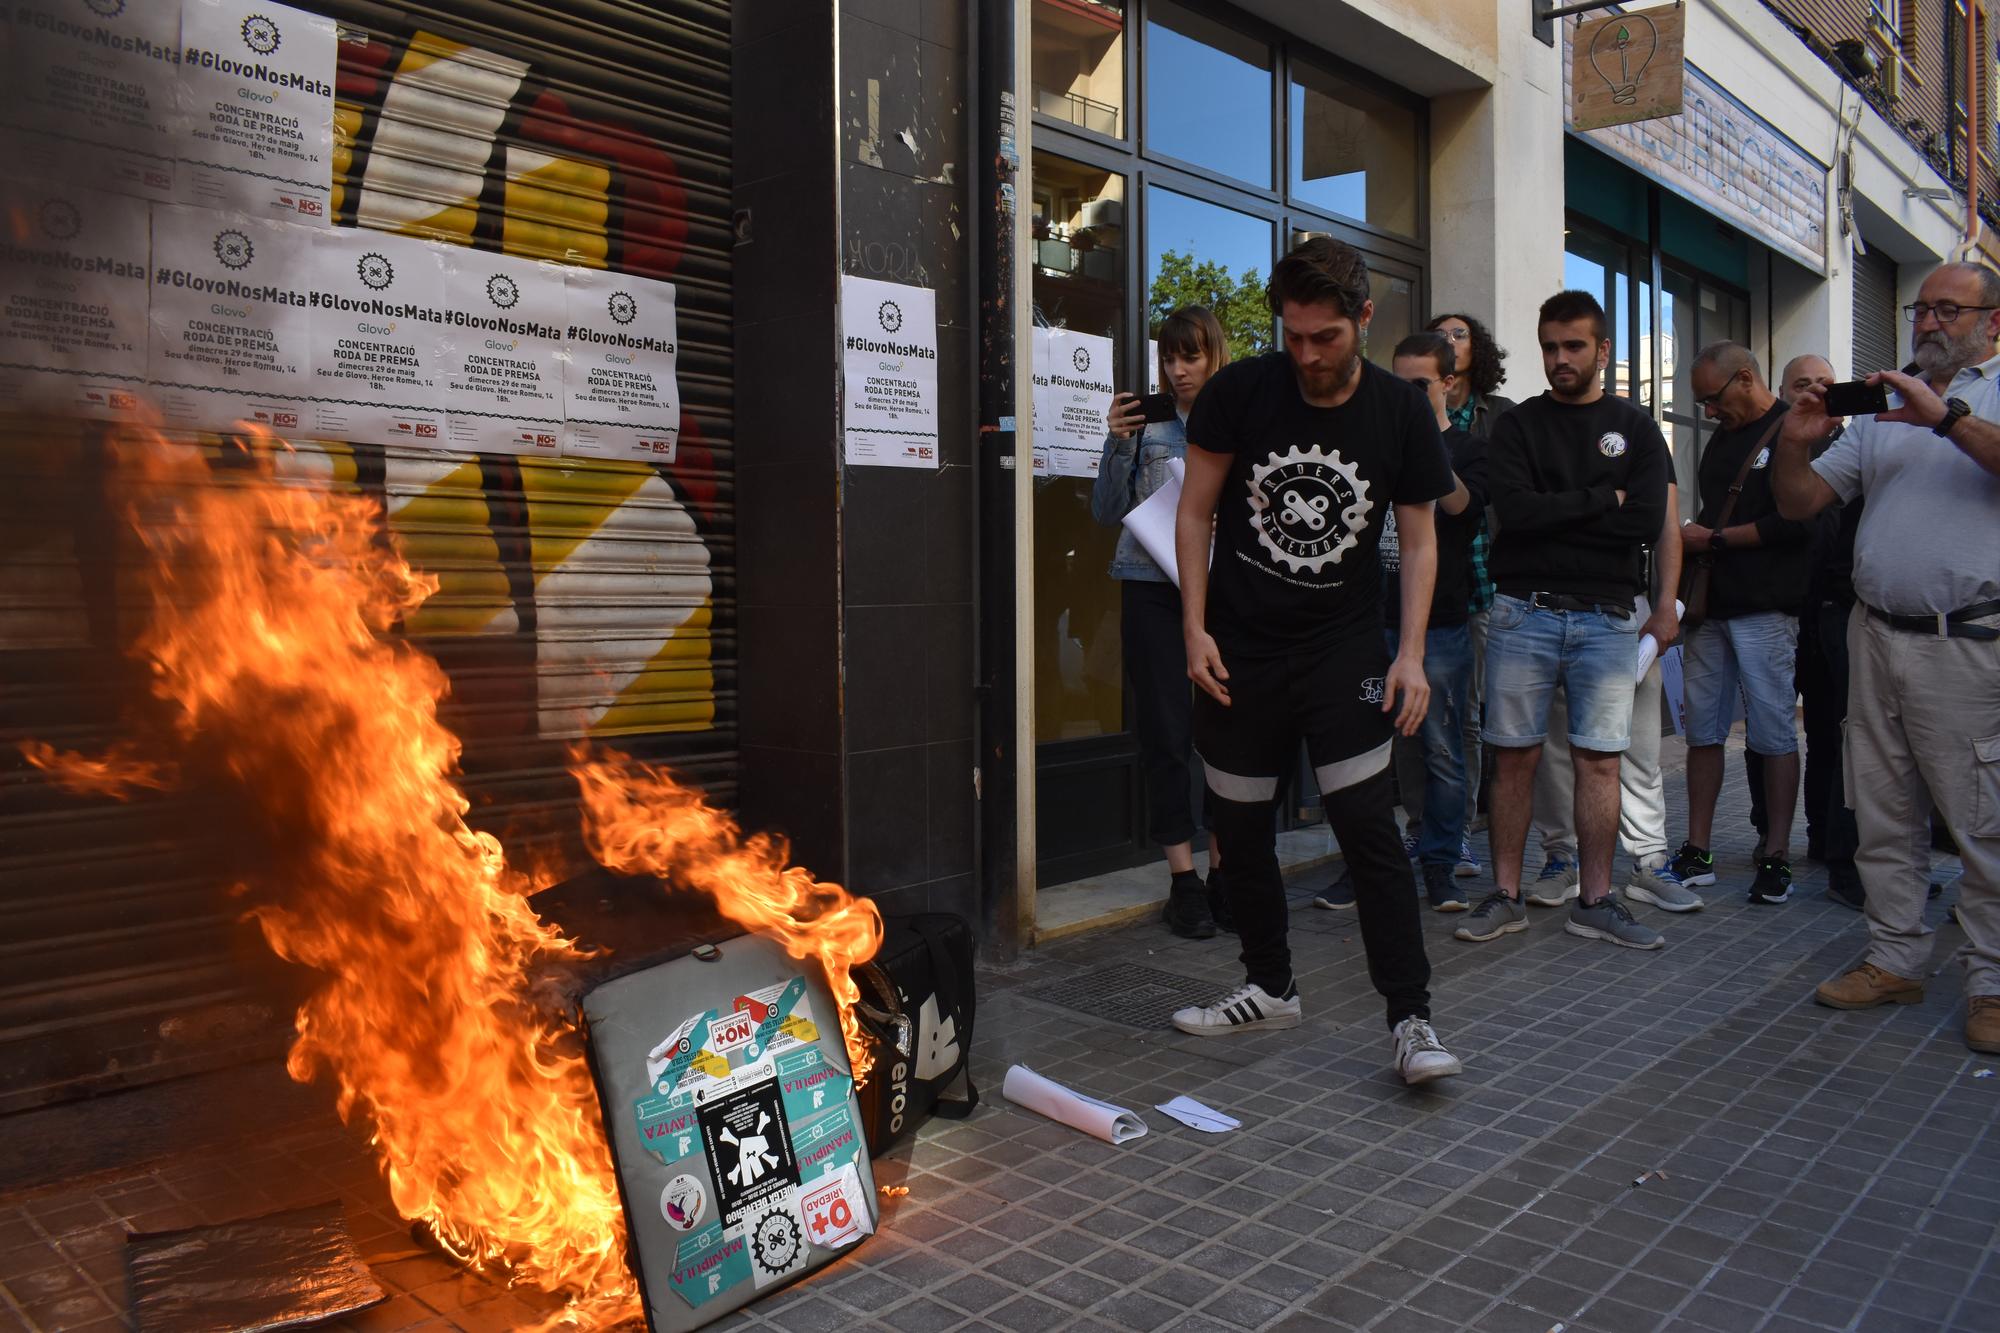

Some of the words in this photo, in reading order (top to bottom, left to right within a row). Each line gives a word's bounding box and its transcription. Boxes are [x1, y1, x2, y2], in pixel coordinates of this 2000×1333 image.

[186, 48, 332, 97] #GlovoNosMata
[237, 87, 273, 104] Glovo
[216, 102, 299, 128] CONCENTRACIÓ
[210, 112, 240, 126] RODA
[244, 119, 257, 130] DE
[261, 123, 303, 141] PREMSA
[256, 134, 266, 142] 29
[280, 140, 299, 151] maig
[249, 150, 266, 160] 18h.
[299, 199, 322, 212] NO+
[0, 240, 145, 279] GlovoNosMata
[157, 268, 306, 307] #GlovoNosMata
[12, 295, 109, 316] CONCENTRACIÓ
[211, 304, 247, 318] Glovo
[309, 291, 442, 324] #GlovoNosMata
[6, 307, 40, 319] RODA
[44, 311, 60, 322] DE
[64, 314, 114, 329] PREMSA
[445, 310, 560, 340] #GlovoNosMata
[189, 320, 274, 340] CONCENTRACIÓ
[358, 322, 390, 335] Glovo
[184, 331, 214, 343] RODA
[218, 336, 232, 346] DE
[235, 338, 279, 352] PREMSA
[339, 339, 415, 356] CONCENTRACIÓ
[485, 340, 513, 351] Glovo
[568, 327, 674, 354] #GlovoNosMata
[847, 336, 935, 360] #GlovoNosMata
[231, 349, 241, 357] 29
[255, 353, 275, 363] maig
[334, 350, 361, 360] RODA
[365, 353, 377, 362] DE
[380, 354, 419, 367] PREMSA
[468, 355, 535, 370] CONCENTRACIÓ
[605, 353, 631, 364] Glovo
[338, 362, 374, 372] dimecres
[398, 369, 415, 377] maig
[464, 365, 489, 374] RODA
[491, 368, 502, 376] DE
[505, 370, 539, 381] PREMSA
[879, 362, 900, 372] Glovo
[396, 376, 423, 386] Romeu,
[468, 376, 500, 385] dimecres
[591, 368, 652, 382] CONCENTRACIÓ
[867, 377, 917, 388] CONCENTRACIÓ
[370, 382, 385, 390] 18h.
[588, 377, 610, 386] RODA
[625, 381, 656, 392] PREMSA
[1051, 374, 1112, 393] #GlovoNosMata
[520, 390, 543, 399] Romeu,
[592, 388, 620, 396] dimecres
[865, 386, 882, 394] RODA
[894, 389, 920, 398] PREMSA
[639, 400, 660, 408] Romeu,
[1064, 406, 1099, 416] CONCENTRACIÓ
[274, 413, 297, 424] NO+
[1083, 416, 1101, 424] PREMSA
[416, 424, 437, 434] NO+
[538, 435, 555, 444] NO+
[653, 441, 669, 450] NO+
[1264, 464, 1353, 498] RIDERS
[1262, 516, 1342, 556] DERECHOS
[713, 1017, 747, 1032] PRECARIETAT
[715, 1022, 750, 1046] NO+
[724, 1196, 768, 1223] DELIVEROO
[672, 1237, 743, 1285] MANIPULA
